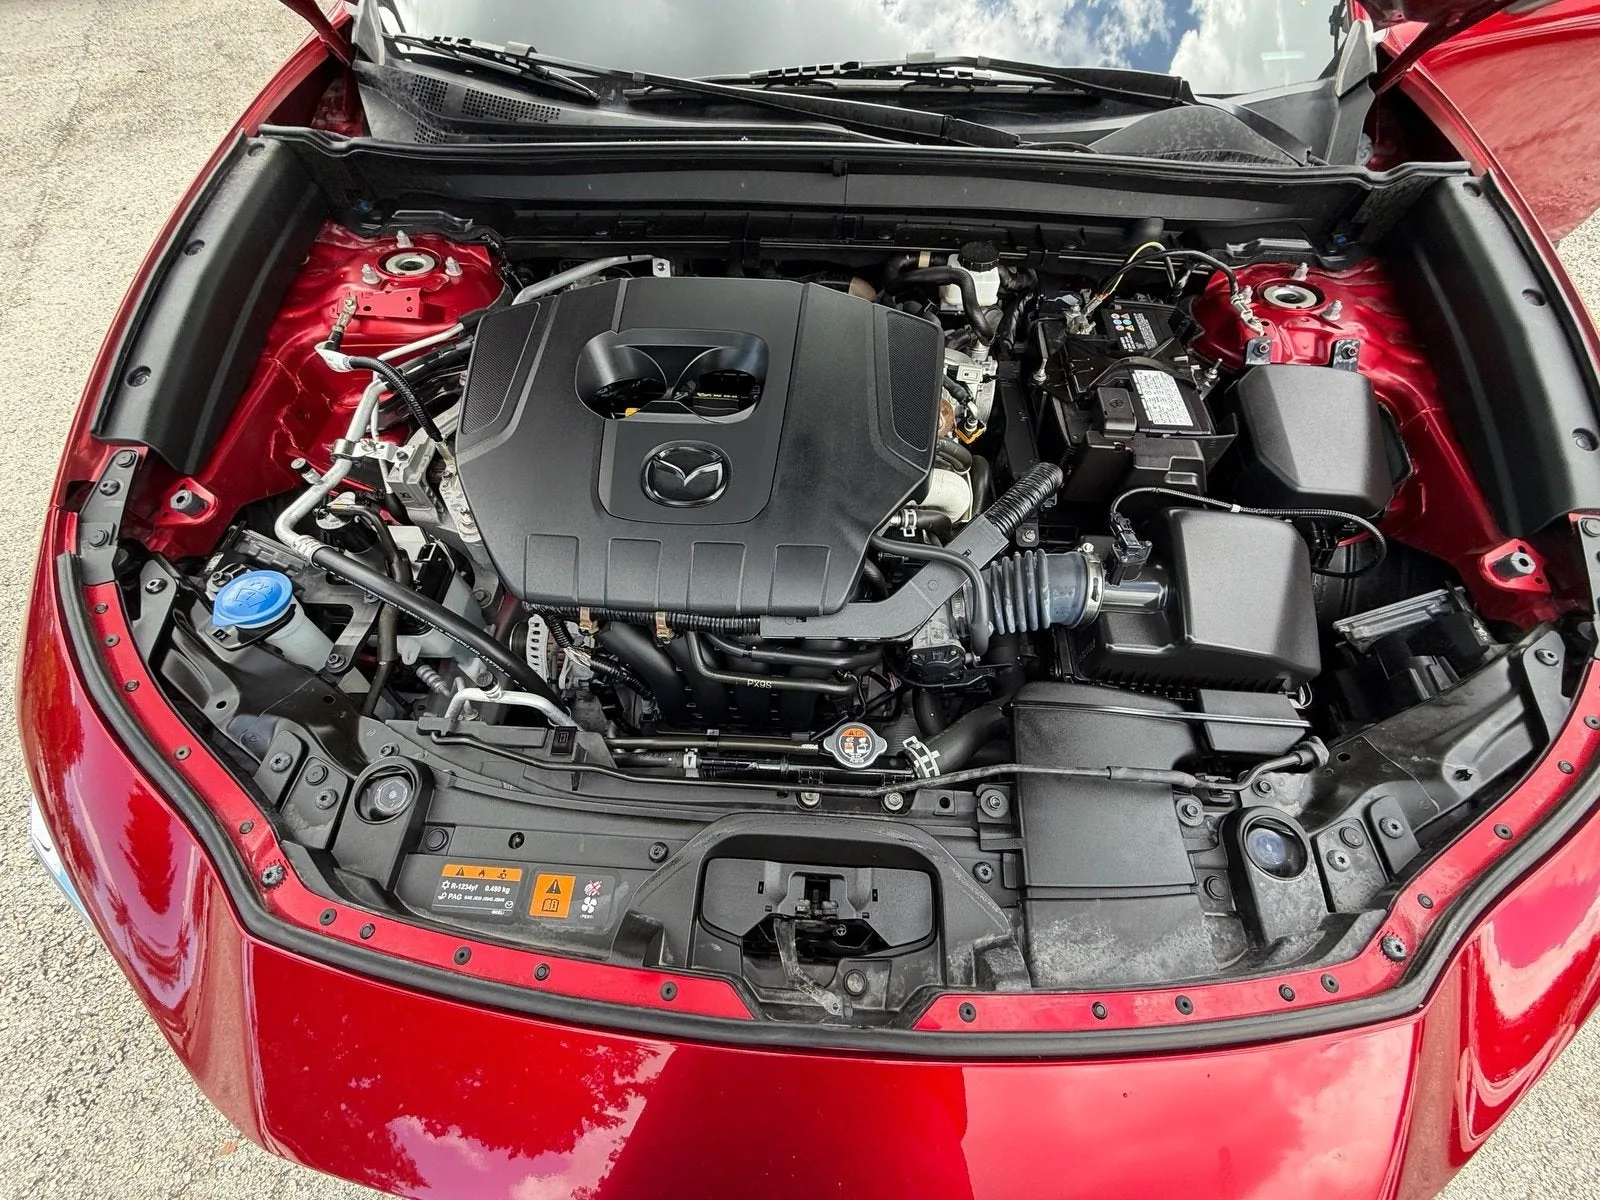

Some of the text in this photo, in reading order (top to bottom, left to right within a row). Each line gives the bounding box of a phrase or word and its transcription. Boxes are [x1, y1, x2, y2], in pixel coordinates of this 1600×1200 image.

[747, 679, 772, 689] PX9S
[450, 882, 479, 892] R-1234yf
[501, 886, 511, 895] kg
